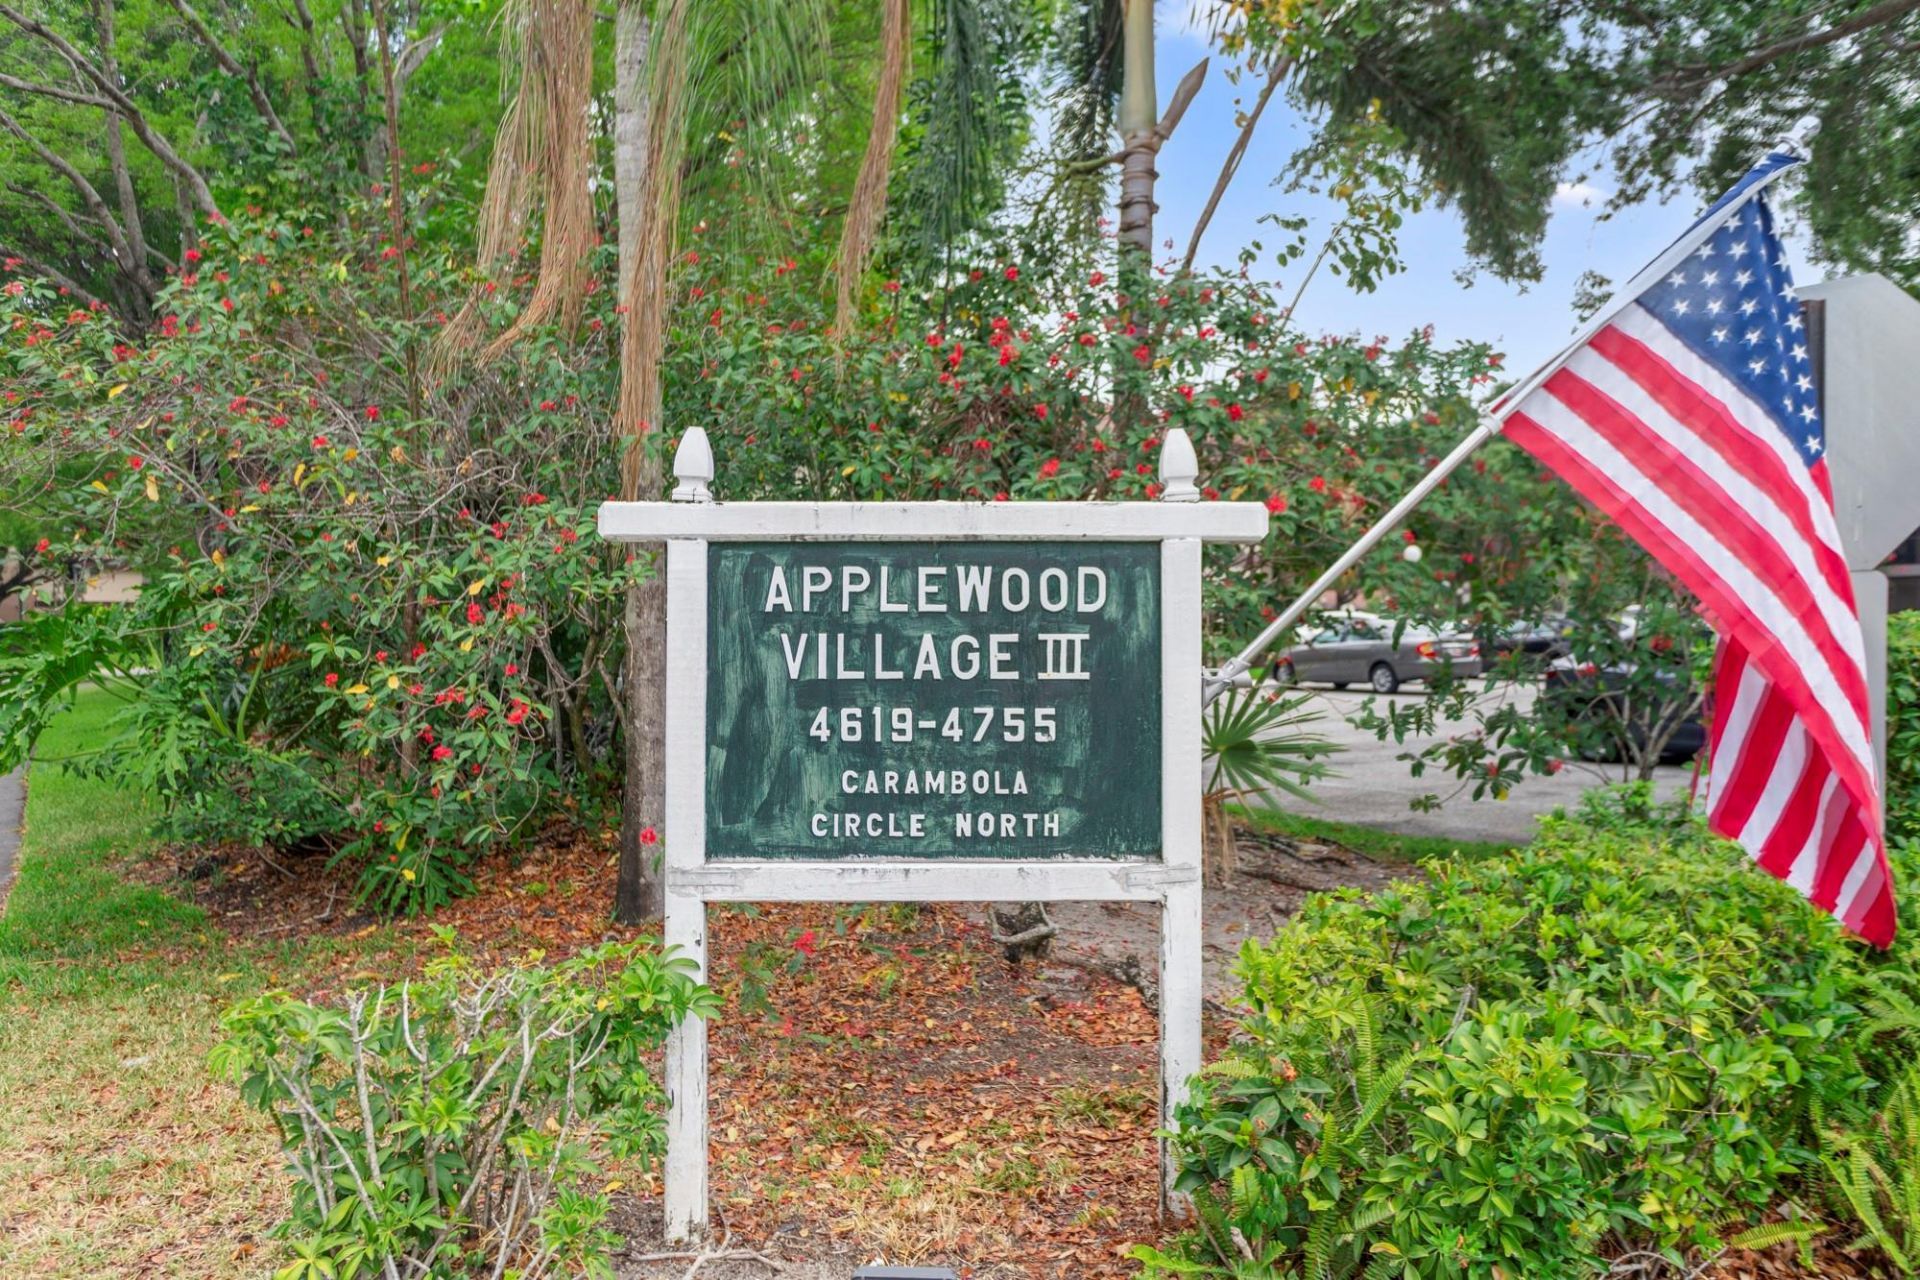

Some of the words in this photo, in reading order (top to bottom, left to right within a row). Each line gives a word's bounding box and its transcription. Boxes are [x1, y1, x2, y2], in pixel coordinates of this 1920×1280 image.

[764, 565, 1107, 613] APPLEWOOD
[780, 633, 1019, 680] VILLAGE
[1037, 633, 1091, 680] III
[809, 706, 1057, 742] 4619-4755
[841, 769, 1029, 795] CARAMBOLA
[811, 813, 926, 838] CIRCLE
[955, 813, 1060, 838] NORTH
